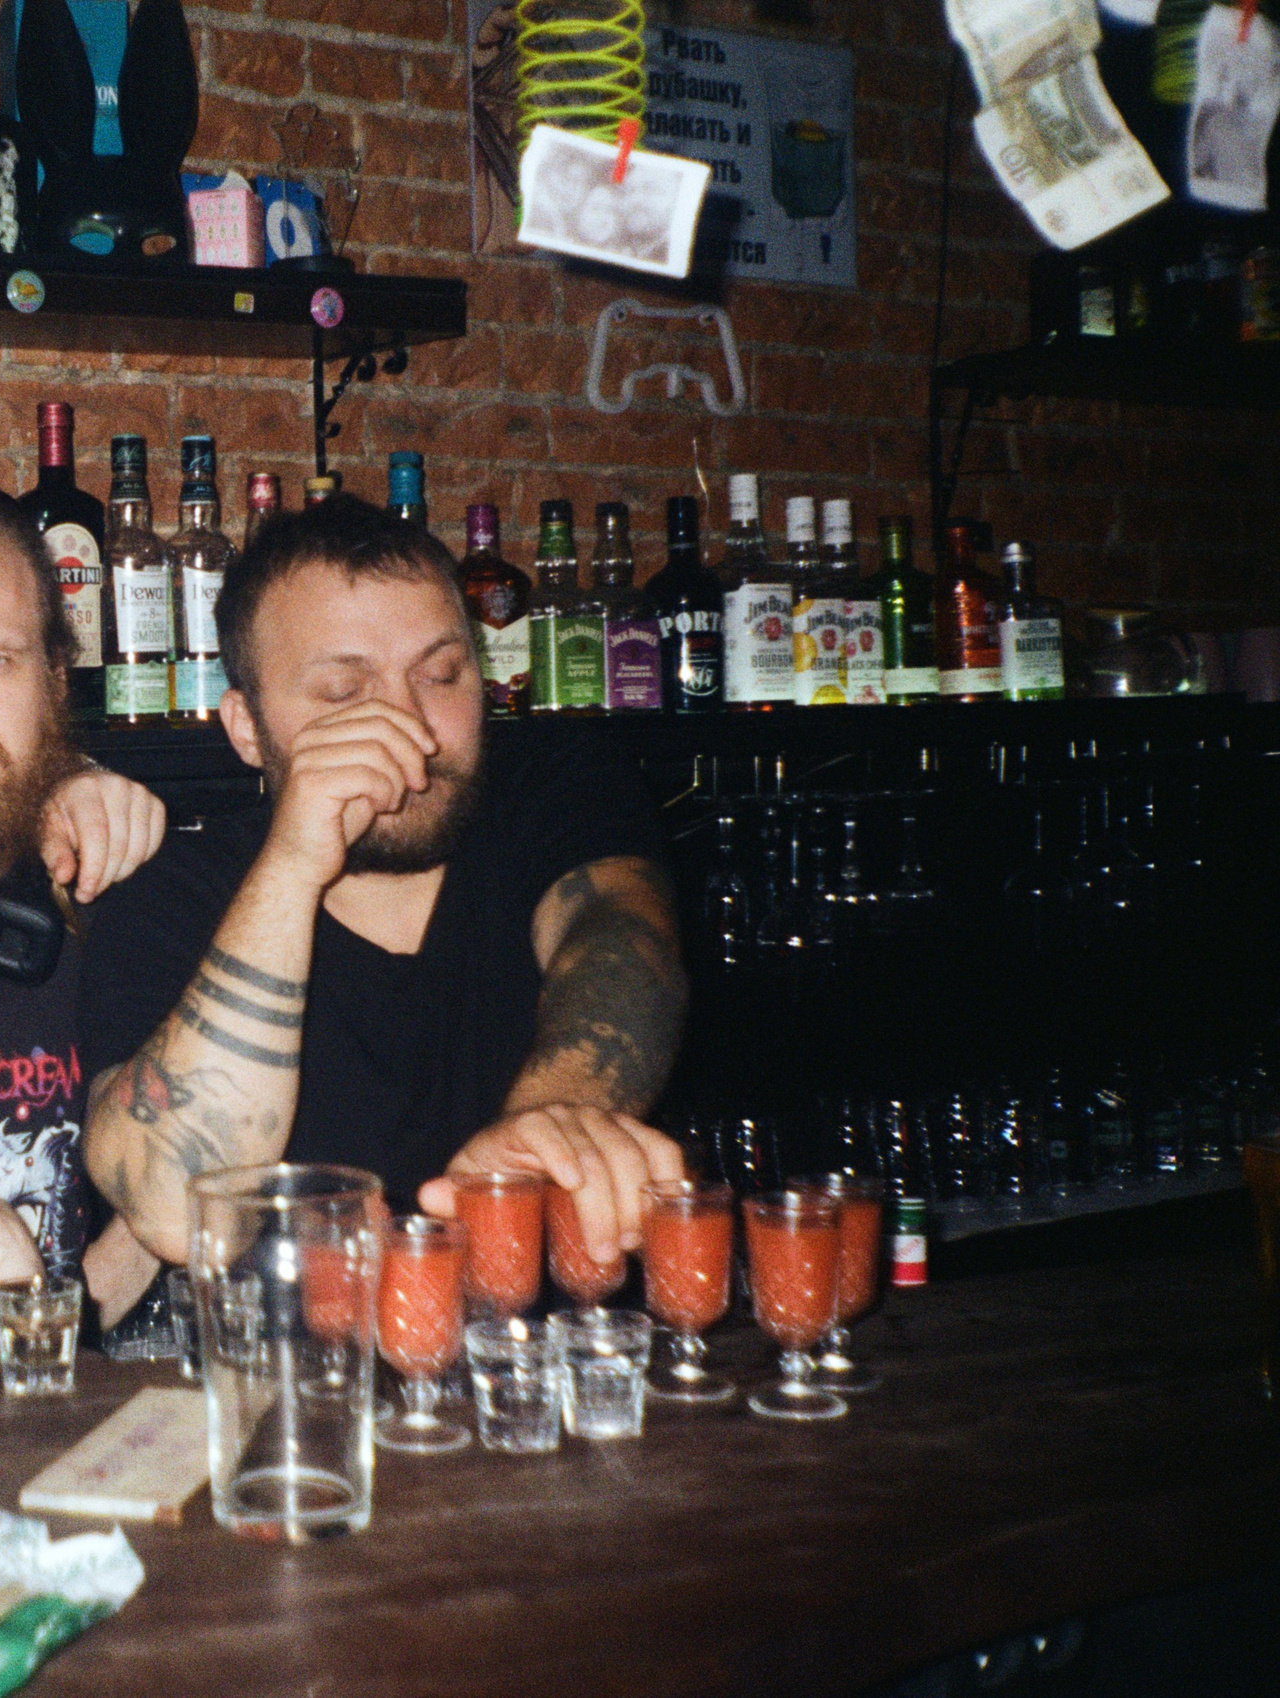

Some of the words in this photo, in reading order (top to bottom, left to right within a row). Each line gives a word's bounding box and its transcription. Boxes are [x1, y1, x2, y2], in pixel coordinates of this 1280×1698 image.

[661, 29, 726, 64] Рвать
[647, 70, 748, 111] рубашку,
[736, 122, 752, 146] и
